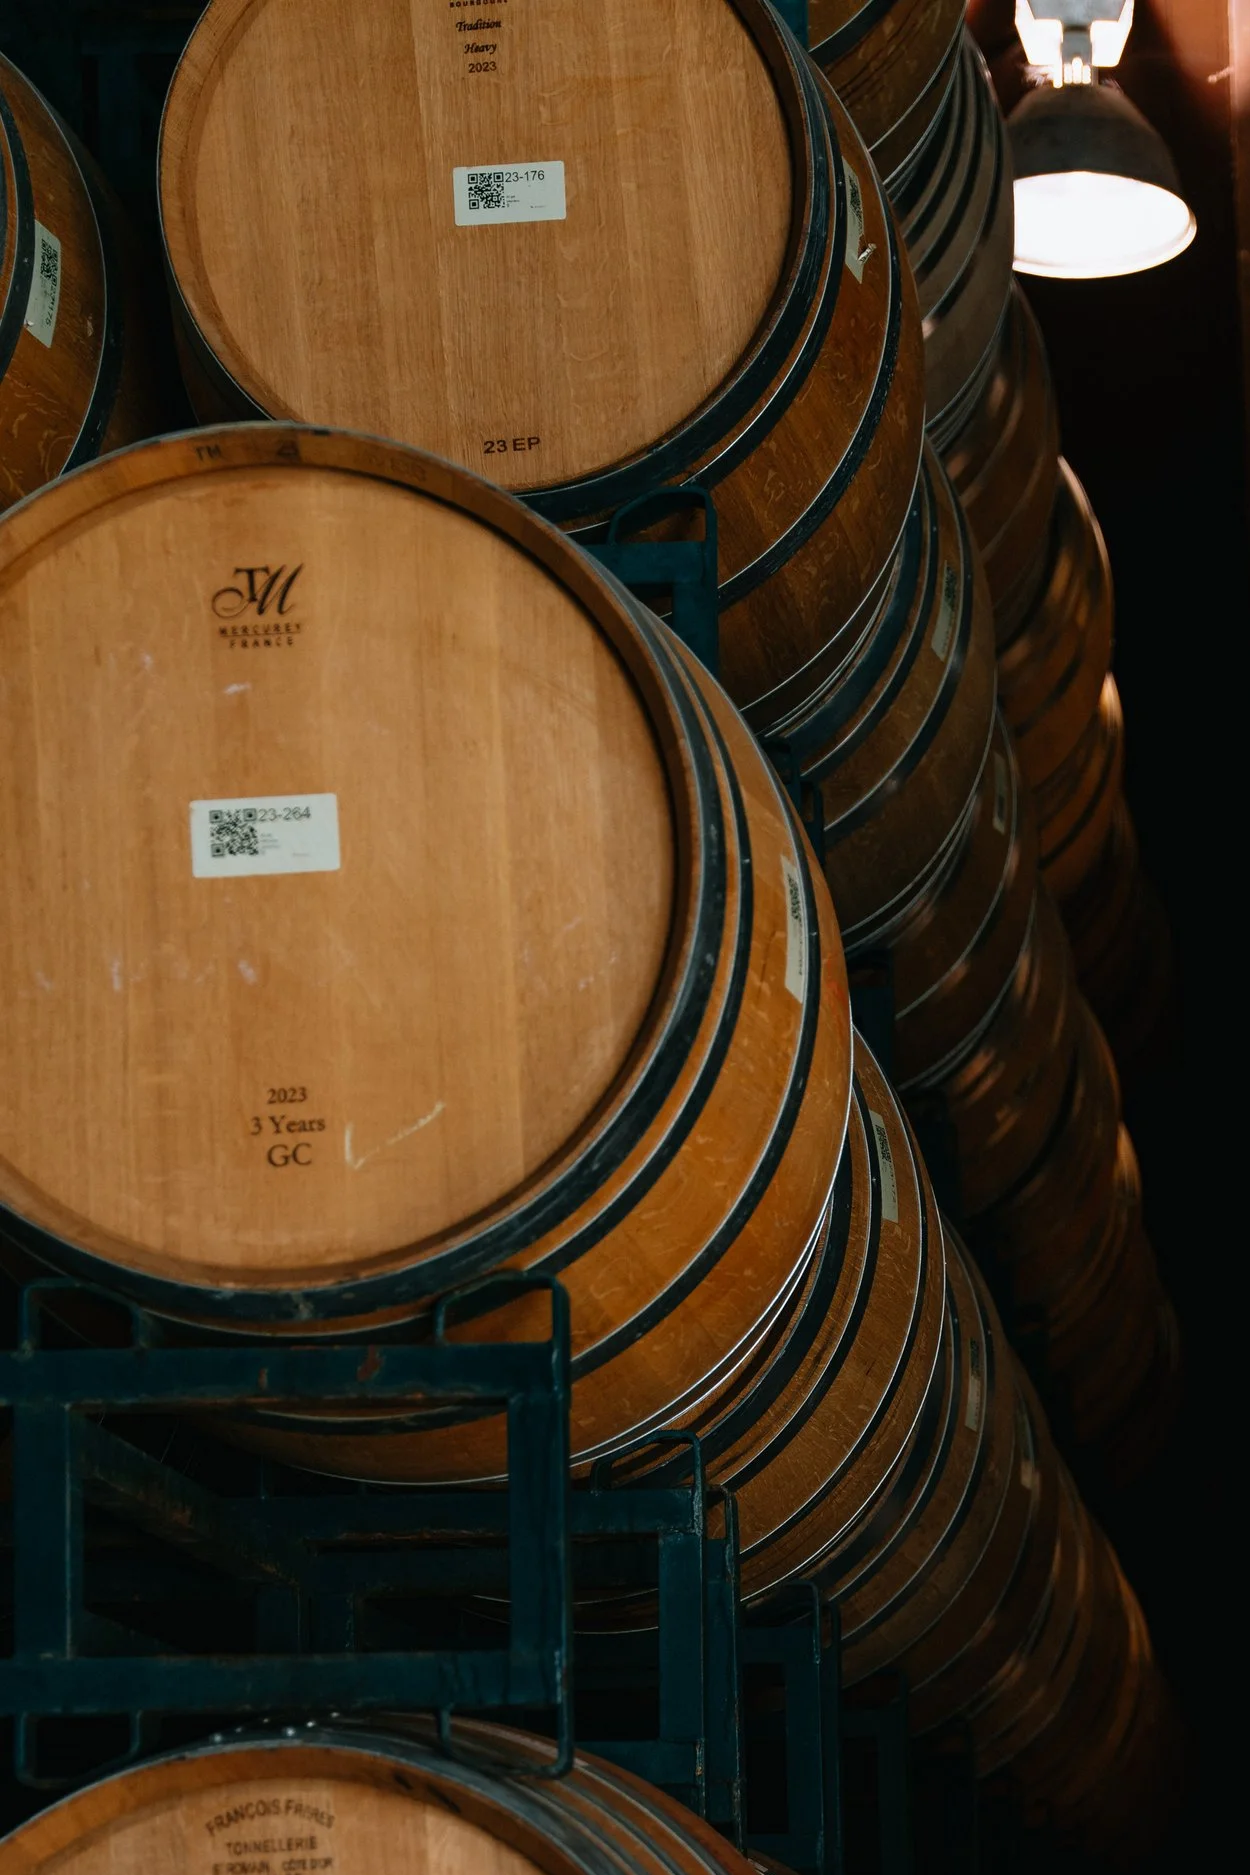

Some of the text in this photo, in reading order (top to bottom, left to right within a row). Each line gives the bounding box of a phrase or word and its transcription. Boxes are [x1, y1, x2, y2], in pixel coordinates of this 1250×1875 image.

[455, 18, 502, 33] Tradition
[464, 42, 497, 55] Heavy
[468, 61, 497, 73] 2023
[505, 170, 545, 183] 23-176
[483, 436, 541, 454] 23 EP
[219, 622, 301, 635] MERCUREY
[229, 637, 294, 649] FRANCE
[258, 806, 311, 822] 23-264
[267, 1086, 308, 1105] 2023
[250, 1114, 326, 1136] 3 Years
[267, 1142, 313, 1168] GC
[226, 1836, 318, 1855] TONNELLERIE
